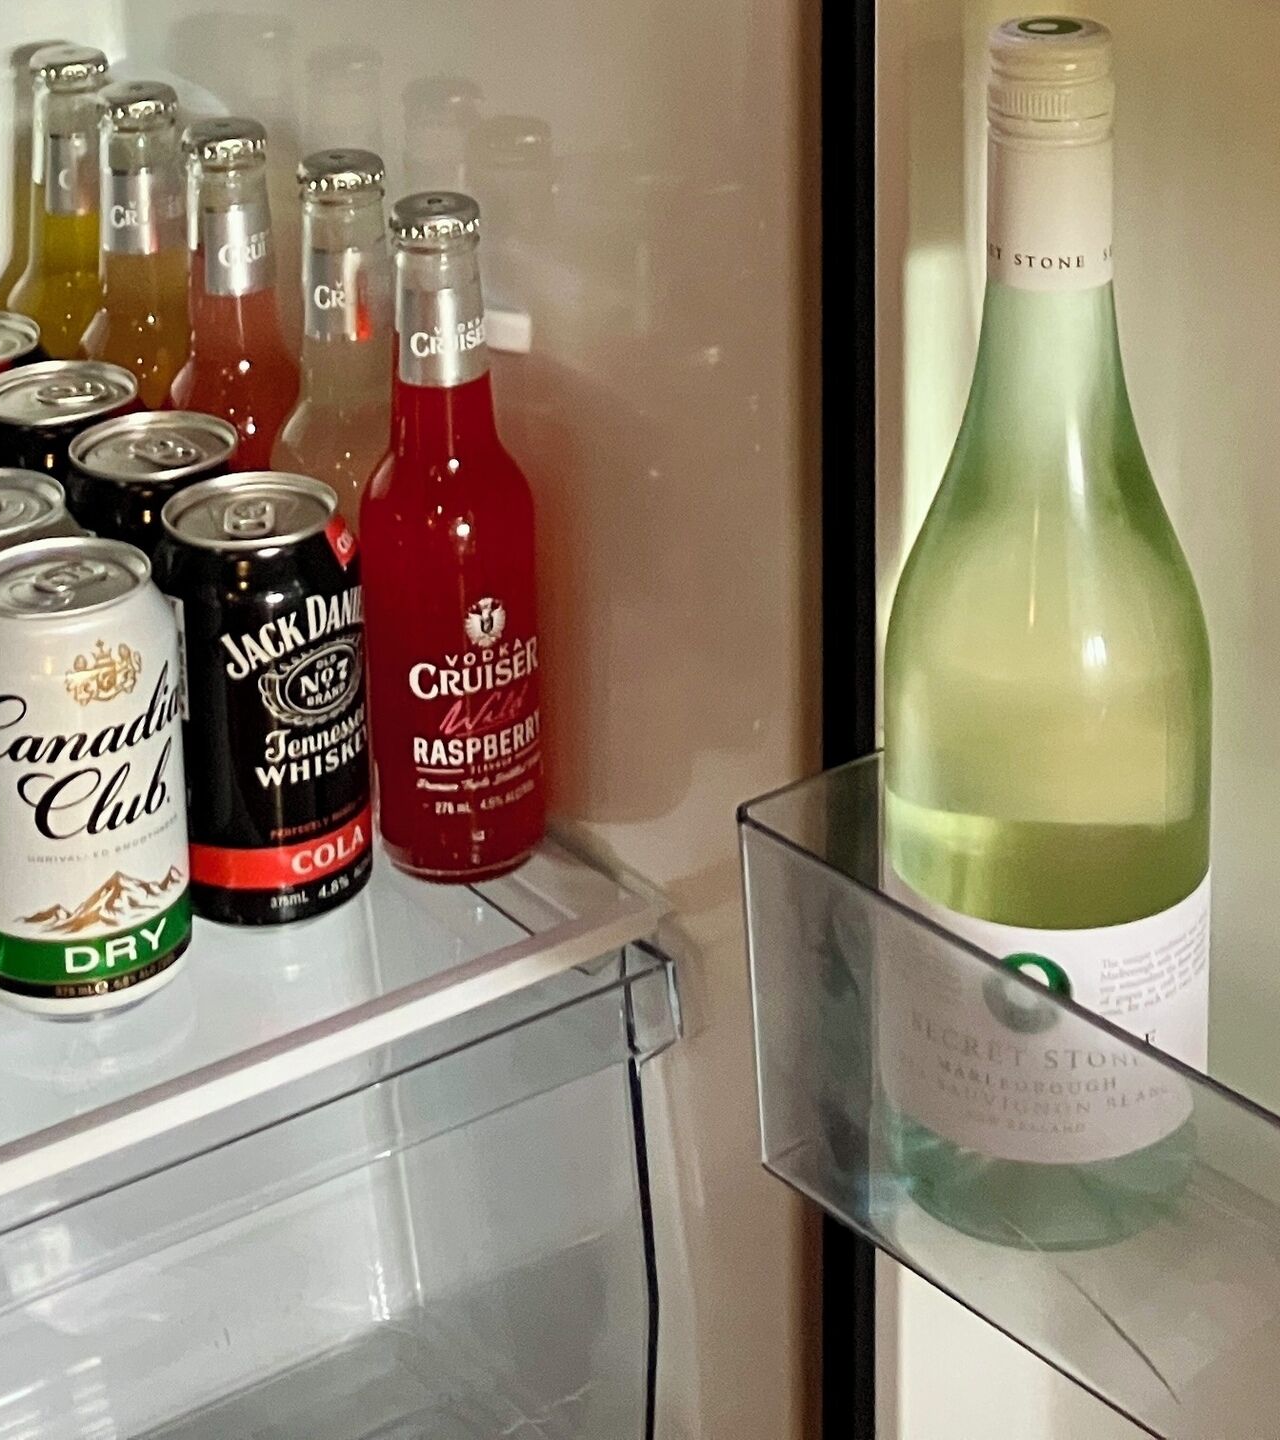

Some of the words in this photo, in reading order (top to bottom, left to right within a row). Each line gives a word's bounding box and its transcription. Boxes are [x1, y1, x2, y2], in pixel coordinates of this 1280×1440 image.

[1013, 252, 1086, 270] STONE
[220, 611, 307, 681] JACK
[408, 635, 540, 700] CRUISER
[444, 637, 524, 668] VODKA
[412, 709, 542, 767] RASPBERRY
[291, 824, 365, 876] COLA
[64, 917, 168, 974] DRY
